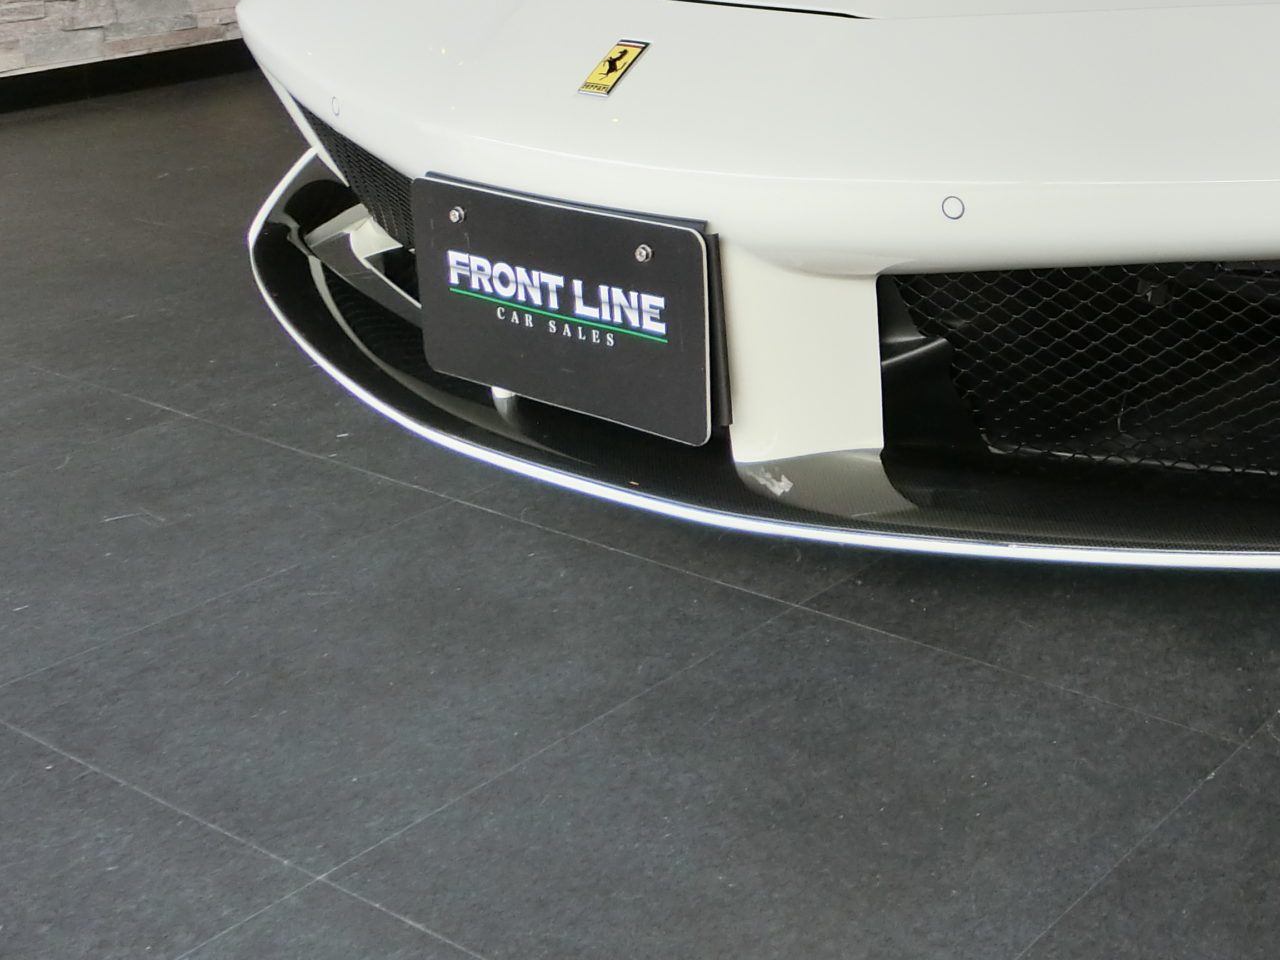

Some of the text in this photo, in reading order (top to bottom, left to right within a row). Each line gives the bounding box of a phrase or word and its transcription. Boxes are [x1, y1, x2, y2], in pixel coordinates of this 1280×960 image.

[447, 250, 667, 335] FRONT LINE
[496, 306, 615, 347] CAR SALES
